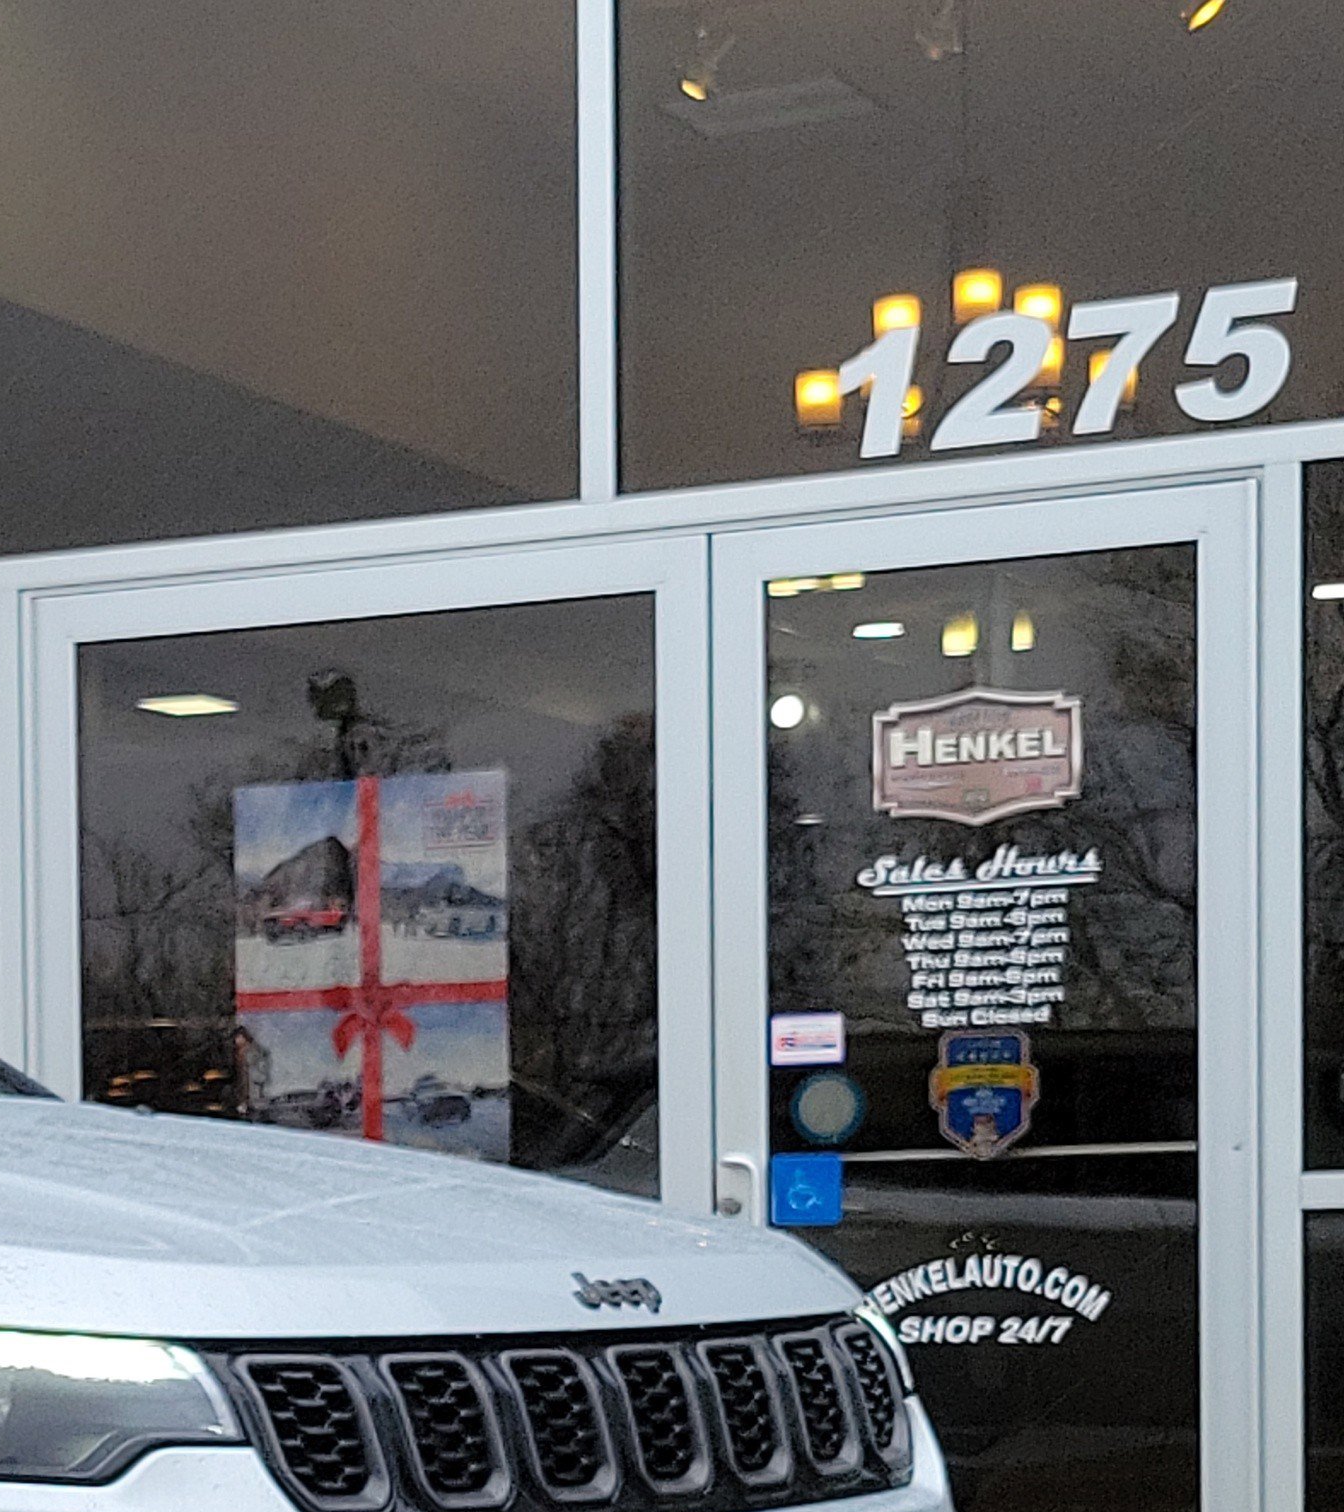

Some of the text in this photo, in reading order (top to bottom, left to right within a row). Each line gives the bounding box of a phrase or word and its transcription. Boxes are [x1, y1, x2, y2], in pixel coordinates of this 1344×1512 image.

[838, 276, 1298, 460] 1275
[889, 727, 1066, 768] HENKEL
[857, 844, 1103, 888] Sales Hours
[902, 896, 954, 913] Mon
[905, 914, 947, 932] Tue
[901, 933, 955, 951] Wed
[970, 1004, 1051, 1025] Closed
[571, 1271, 663, 1314] Jeep
[899, 1316, 1073, 1344] SHOP 24/7
